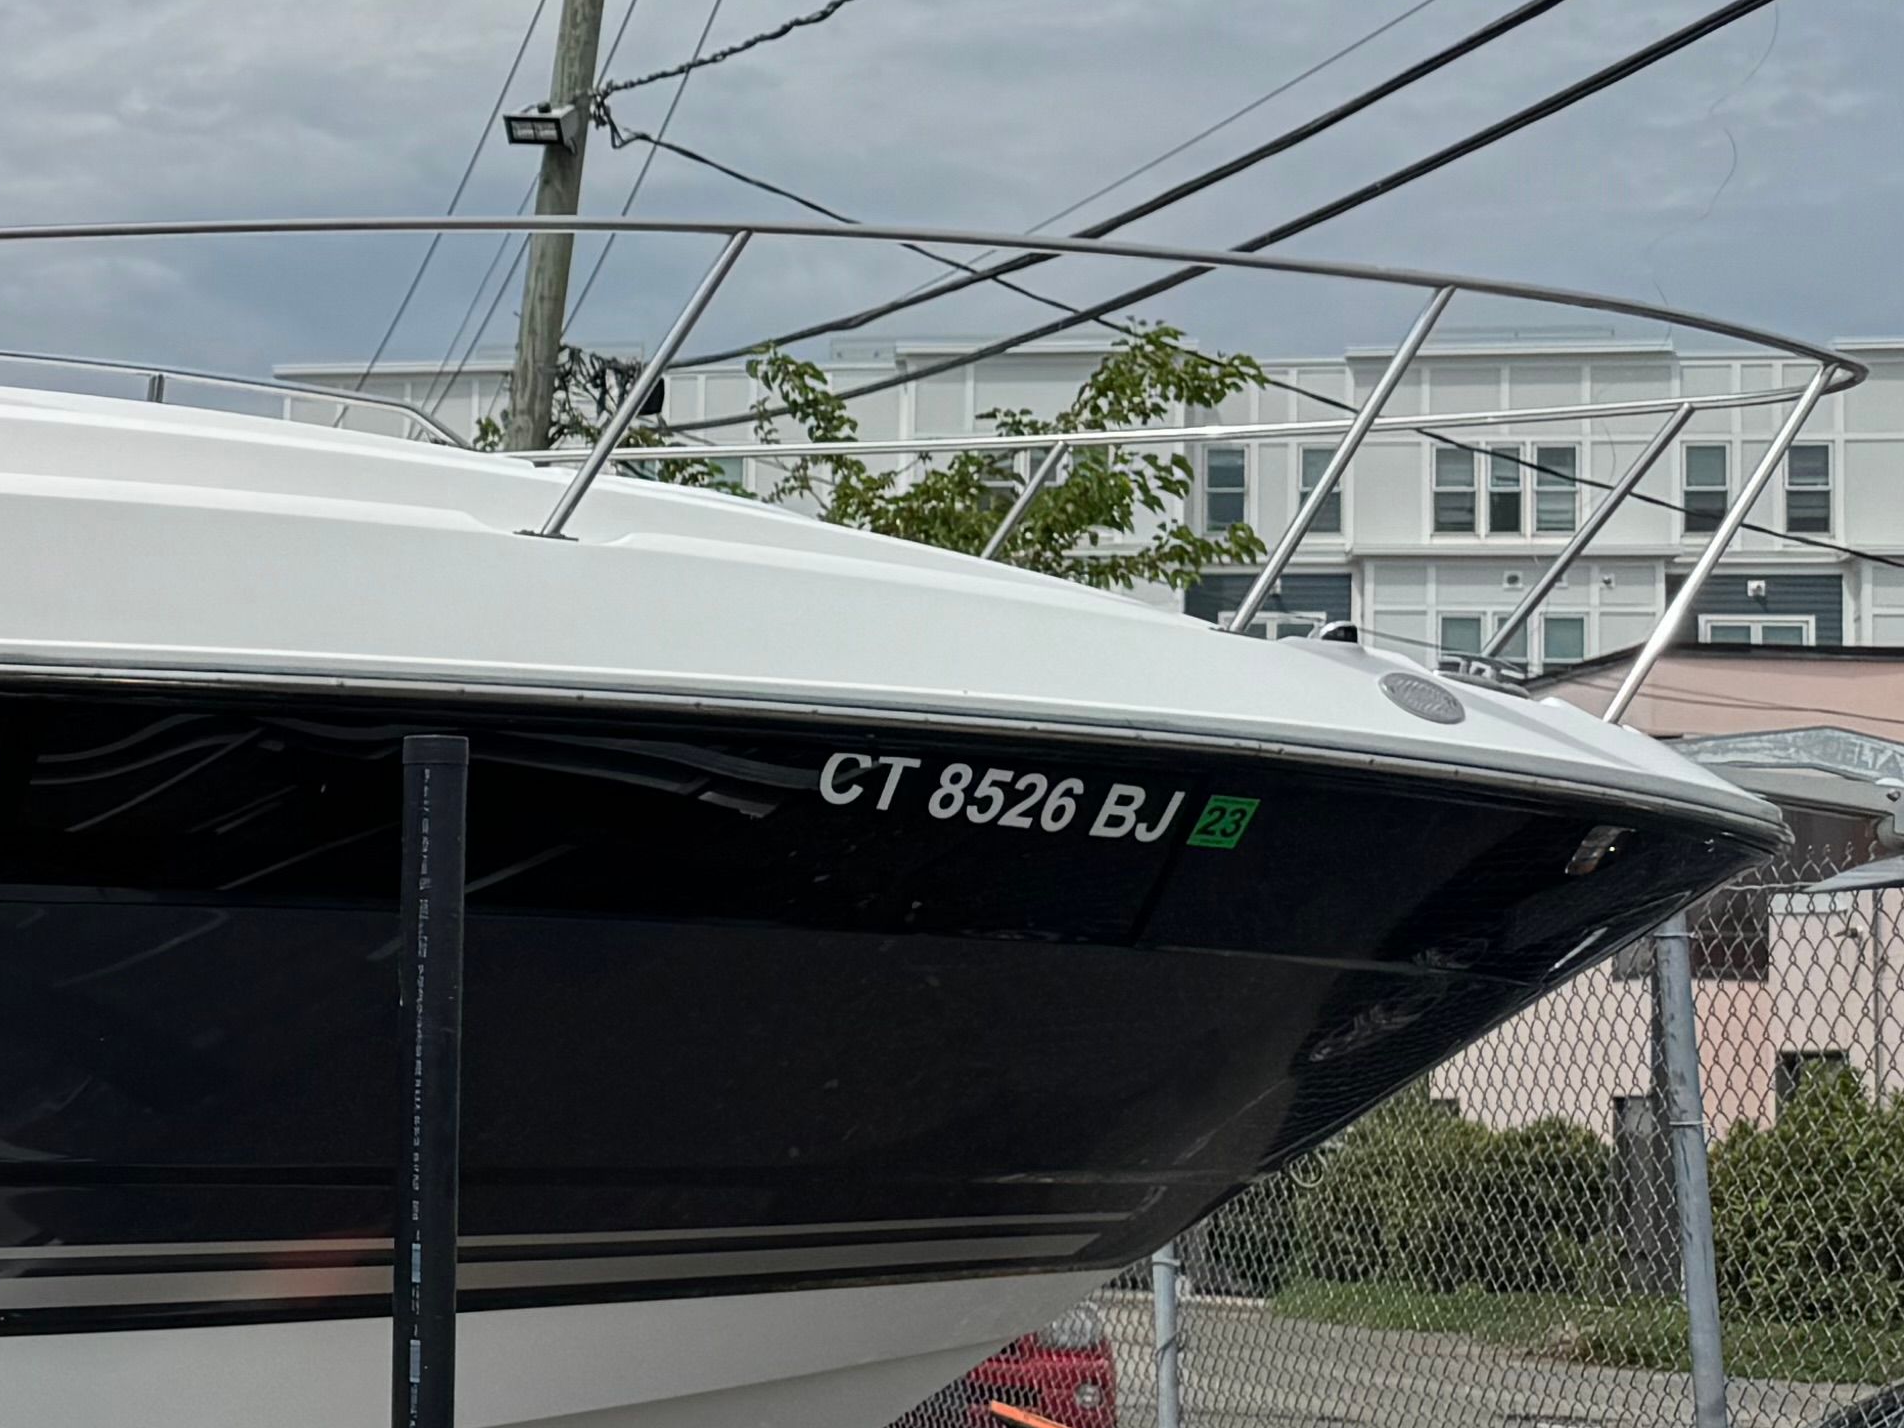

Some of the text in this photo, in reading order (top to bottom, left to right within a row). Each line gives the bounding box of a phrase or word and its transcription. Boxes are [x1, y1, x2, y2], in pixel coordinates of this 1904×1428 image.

[818, 752, 1186, 843] CT 8526 BJ
[1195, 806, 1248, 838] 23
